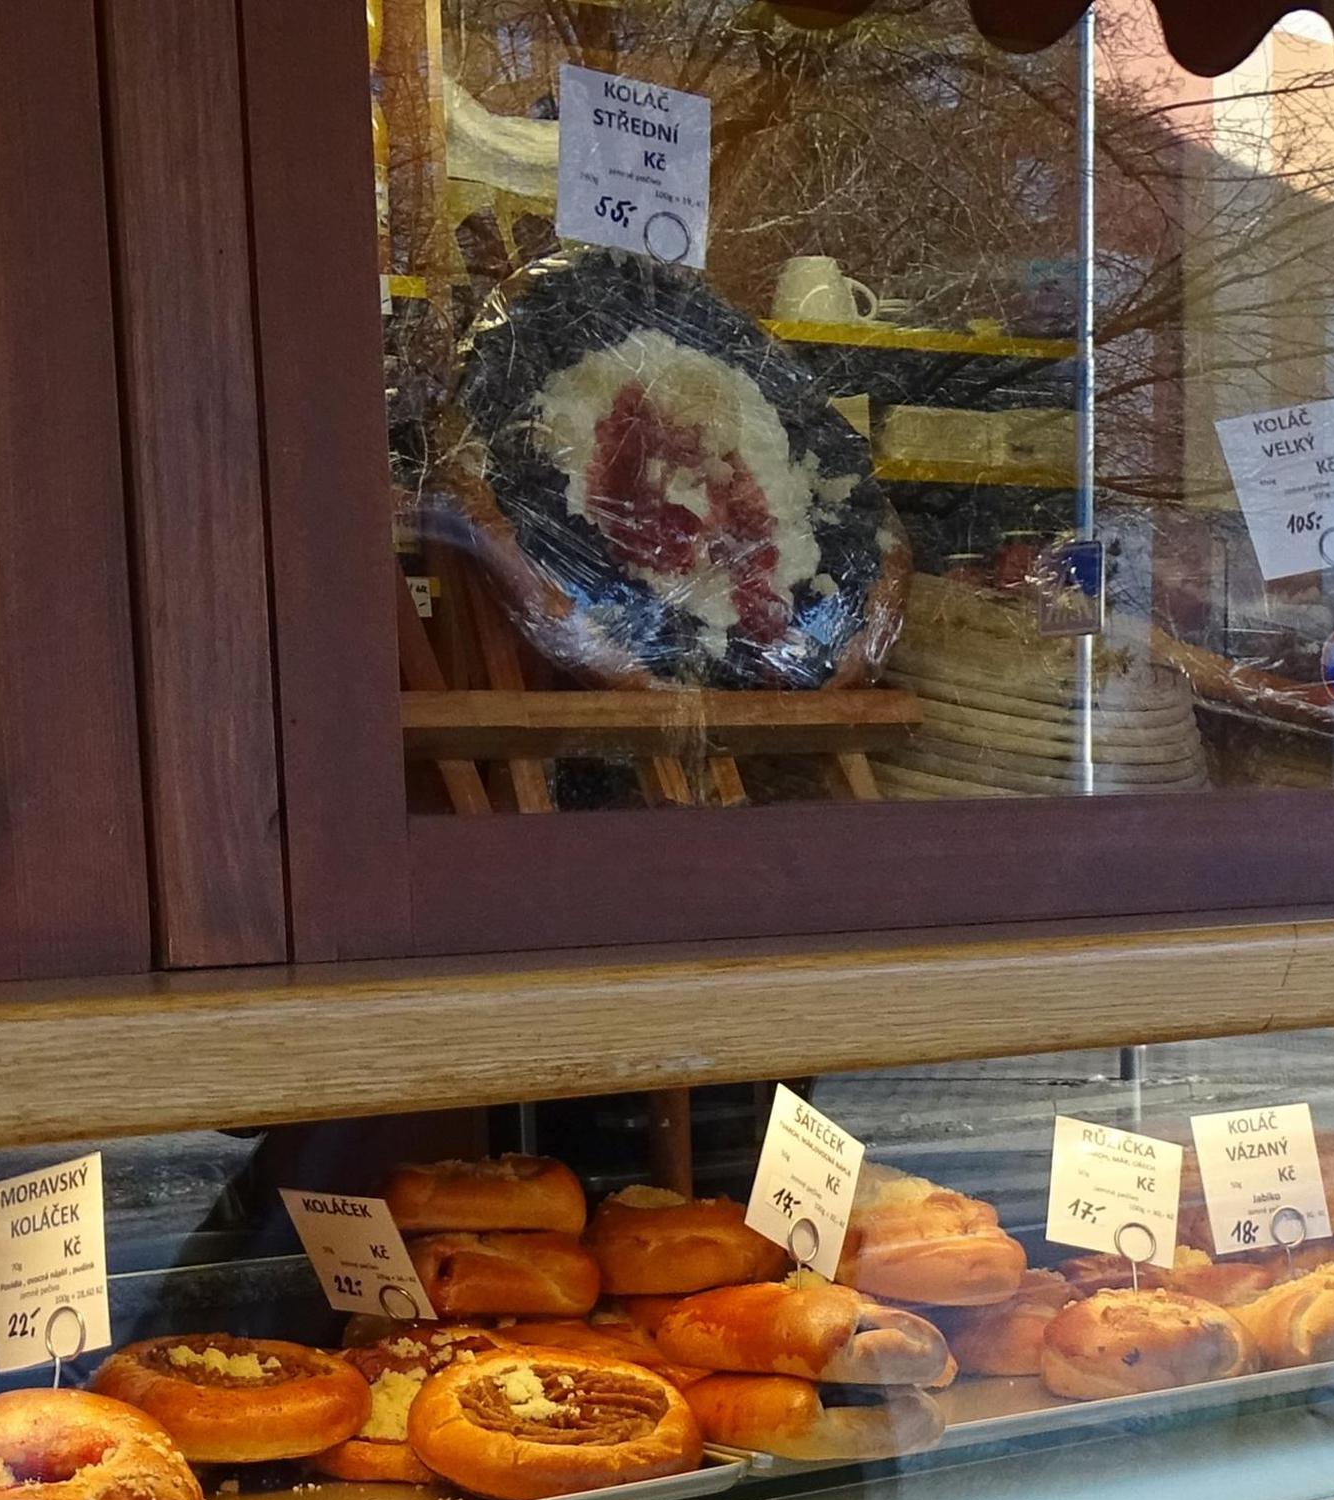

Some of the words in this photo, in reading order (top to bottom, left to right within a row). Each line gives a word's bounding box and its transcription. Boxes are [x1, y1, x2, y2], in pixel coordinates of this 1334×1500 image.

[604, 81, 670, 112] KOLÁČ
[593, 108, 679, 144] STŘEDNÍ
[644, 151, 666, 171] Kč
[1253, 408, 1312, 435] KOLÁČ
[1262, 432, 1315, 458] VELKÝ
[794, 1104, 846, 1155] ŠÁTEČEK
[1228, 1111, 1278, 1134] KOLÁČ
[1226, 1136, 1288, 1162] VÁZANÝ
[0, 1162, 88, 1209] MORAVSKÝ
[826, 1173, 841, 1195] Kč
[1137, 1176, 1155, 1193] Kč
[1278, 1165, 1296, 1182] Kč
[302, 1198, 373, 1219] KOLÁČEK
[10, 1203, 80, 1239] KOLÁČEK
[63, 1235, 81, 1258] Kč
[369, 1244, 390, 1260] Kč
